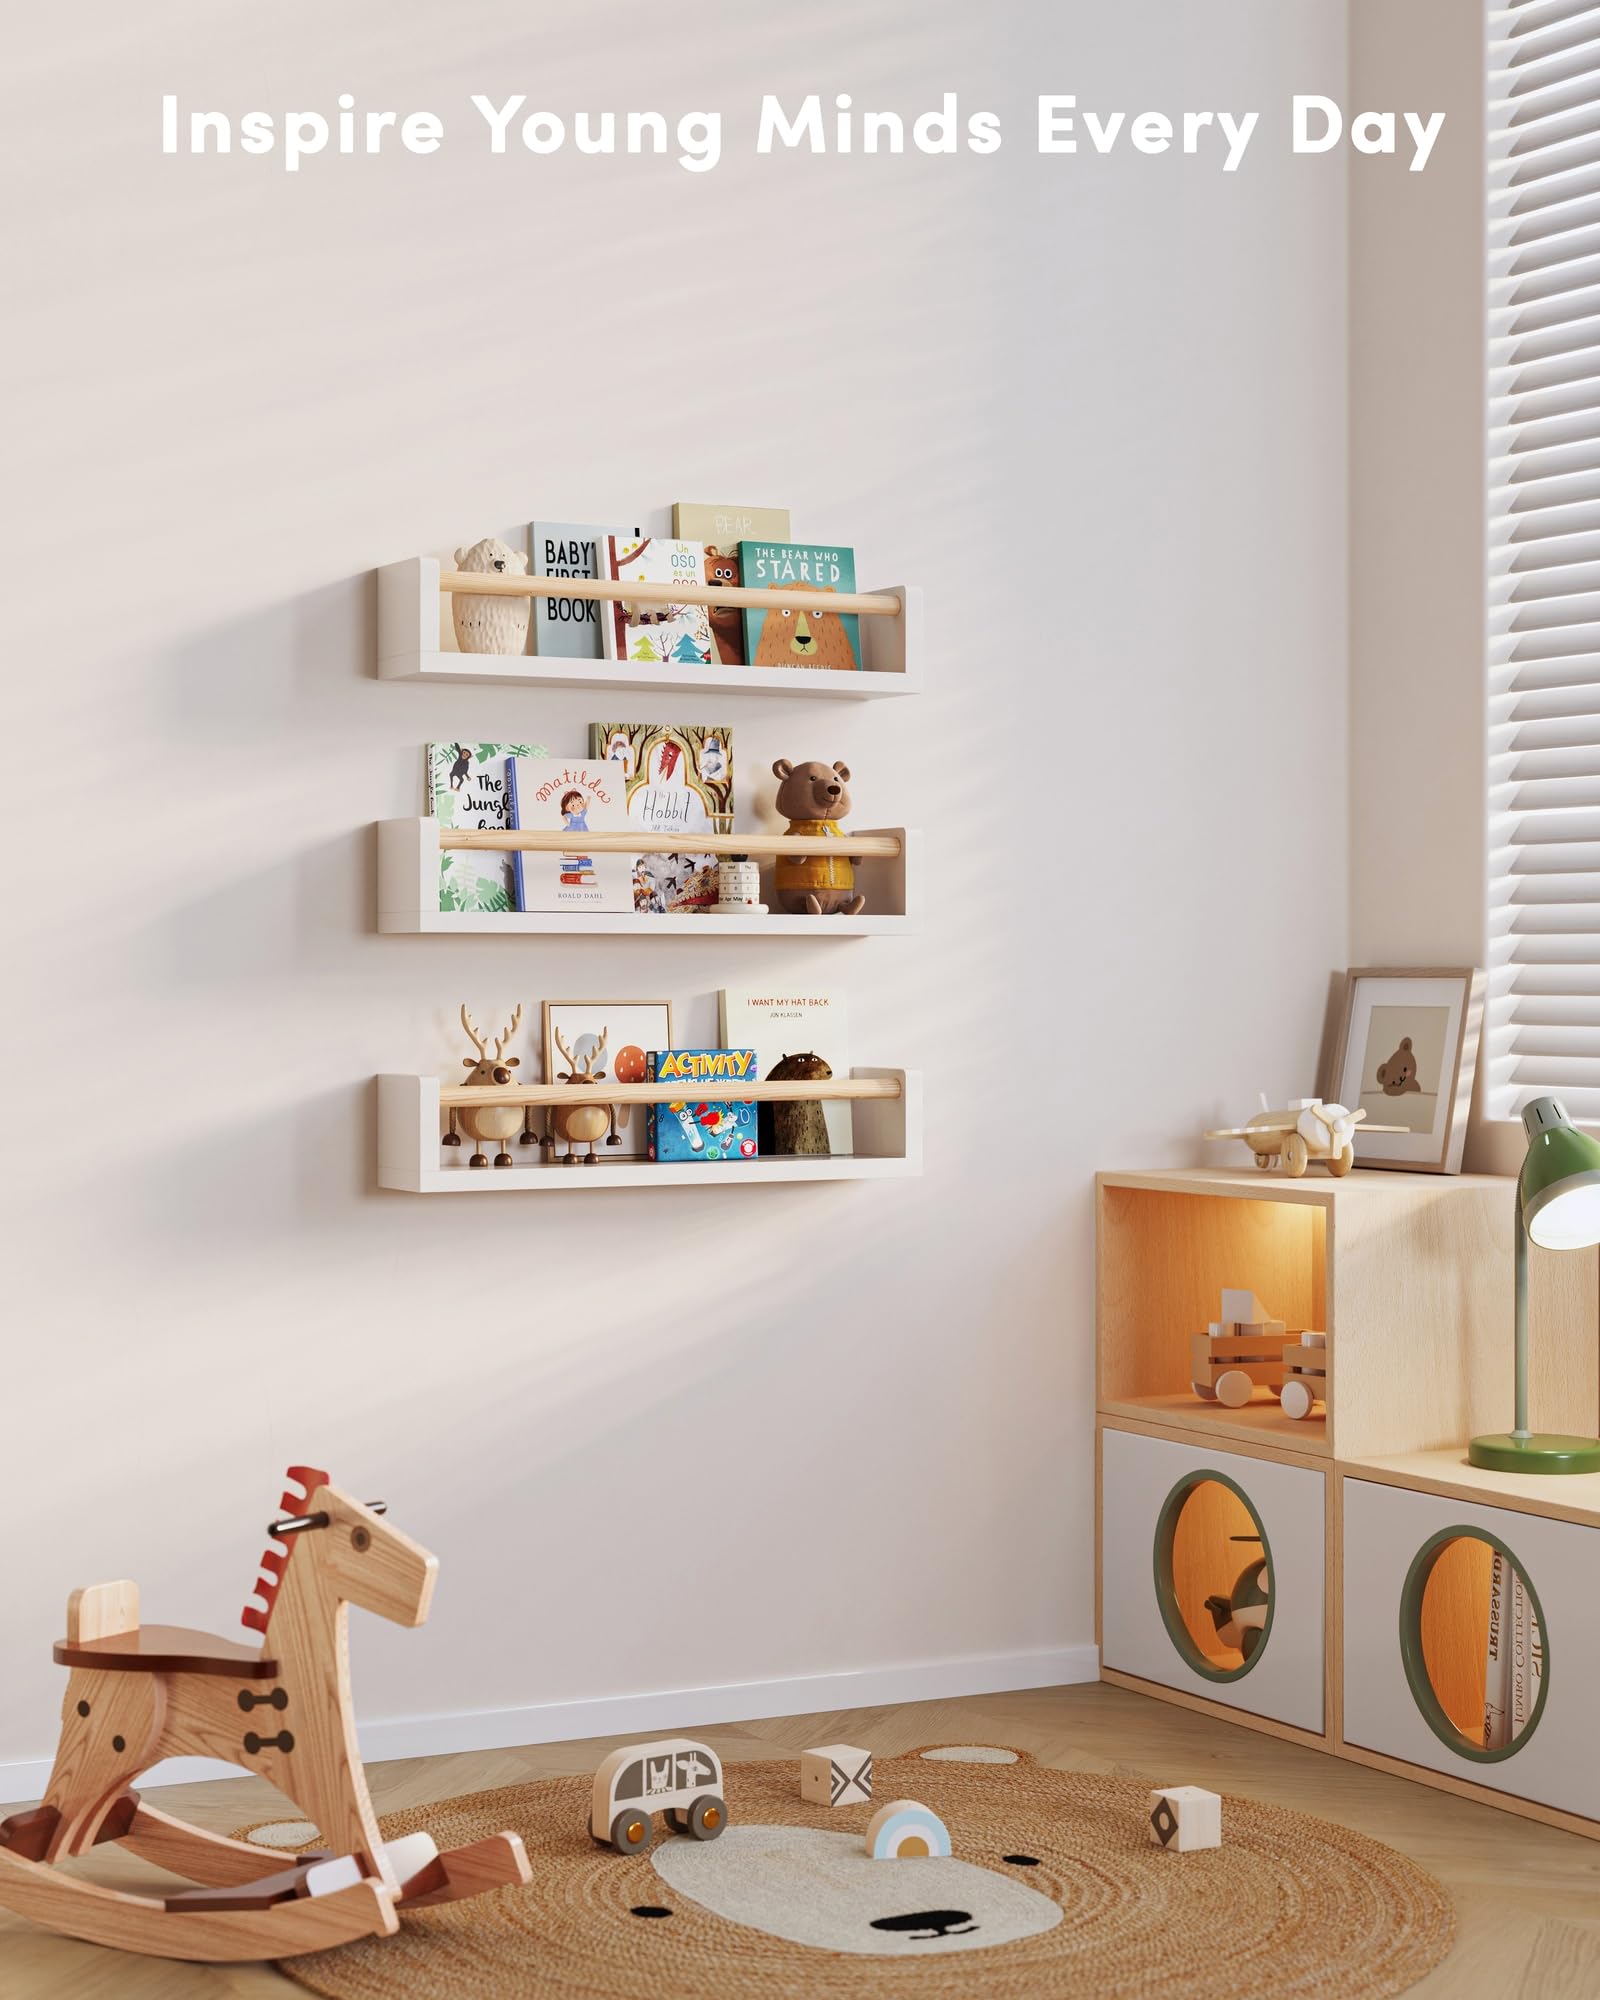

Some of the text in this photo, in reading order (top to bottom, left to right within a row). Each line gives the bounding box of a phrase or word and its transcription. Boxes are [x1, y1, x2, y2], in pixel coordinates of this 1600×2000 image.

[714, 513, 754, 536] BEAR
[545, 539, 596, 565] BABY'
[676, 543, 689, 553] Un
[755, 547, 839, 562] THE BEAR WHO
[756, 559, 840, 582] STARED
[547, 597, 597, 622] BOOK
[476, 774, 503, 792] The
[535, 769, 611, 804] Matilda
[463, 792, 510, 819] Jungl
[643, 789, 691, 823] Hobbit
[752, 998, 774, 1007] WANT
[776, 998, 789, 1007] MY
[791, 998, 806, 1007] HAT
[808, 998, 829, 1007] BACK
[658, 1050, 754, 1079] ACTIVITY
